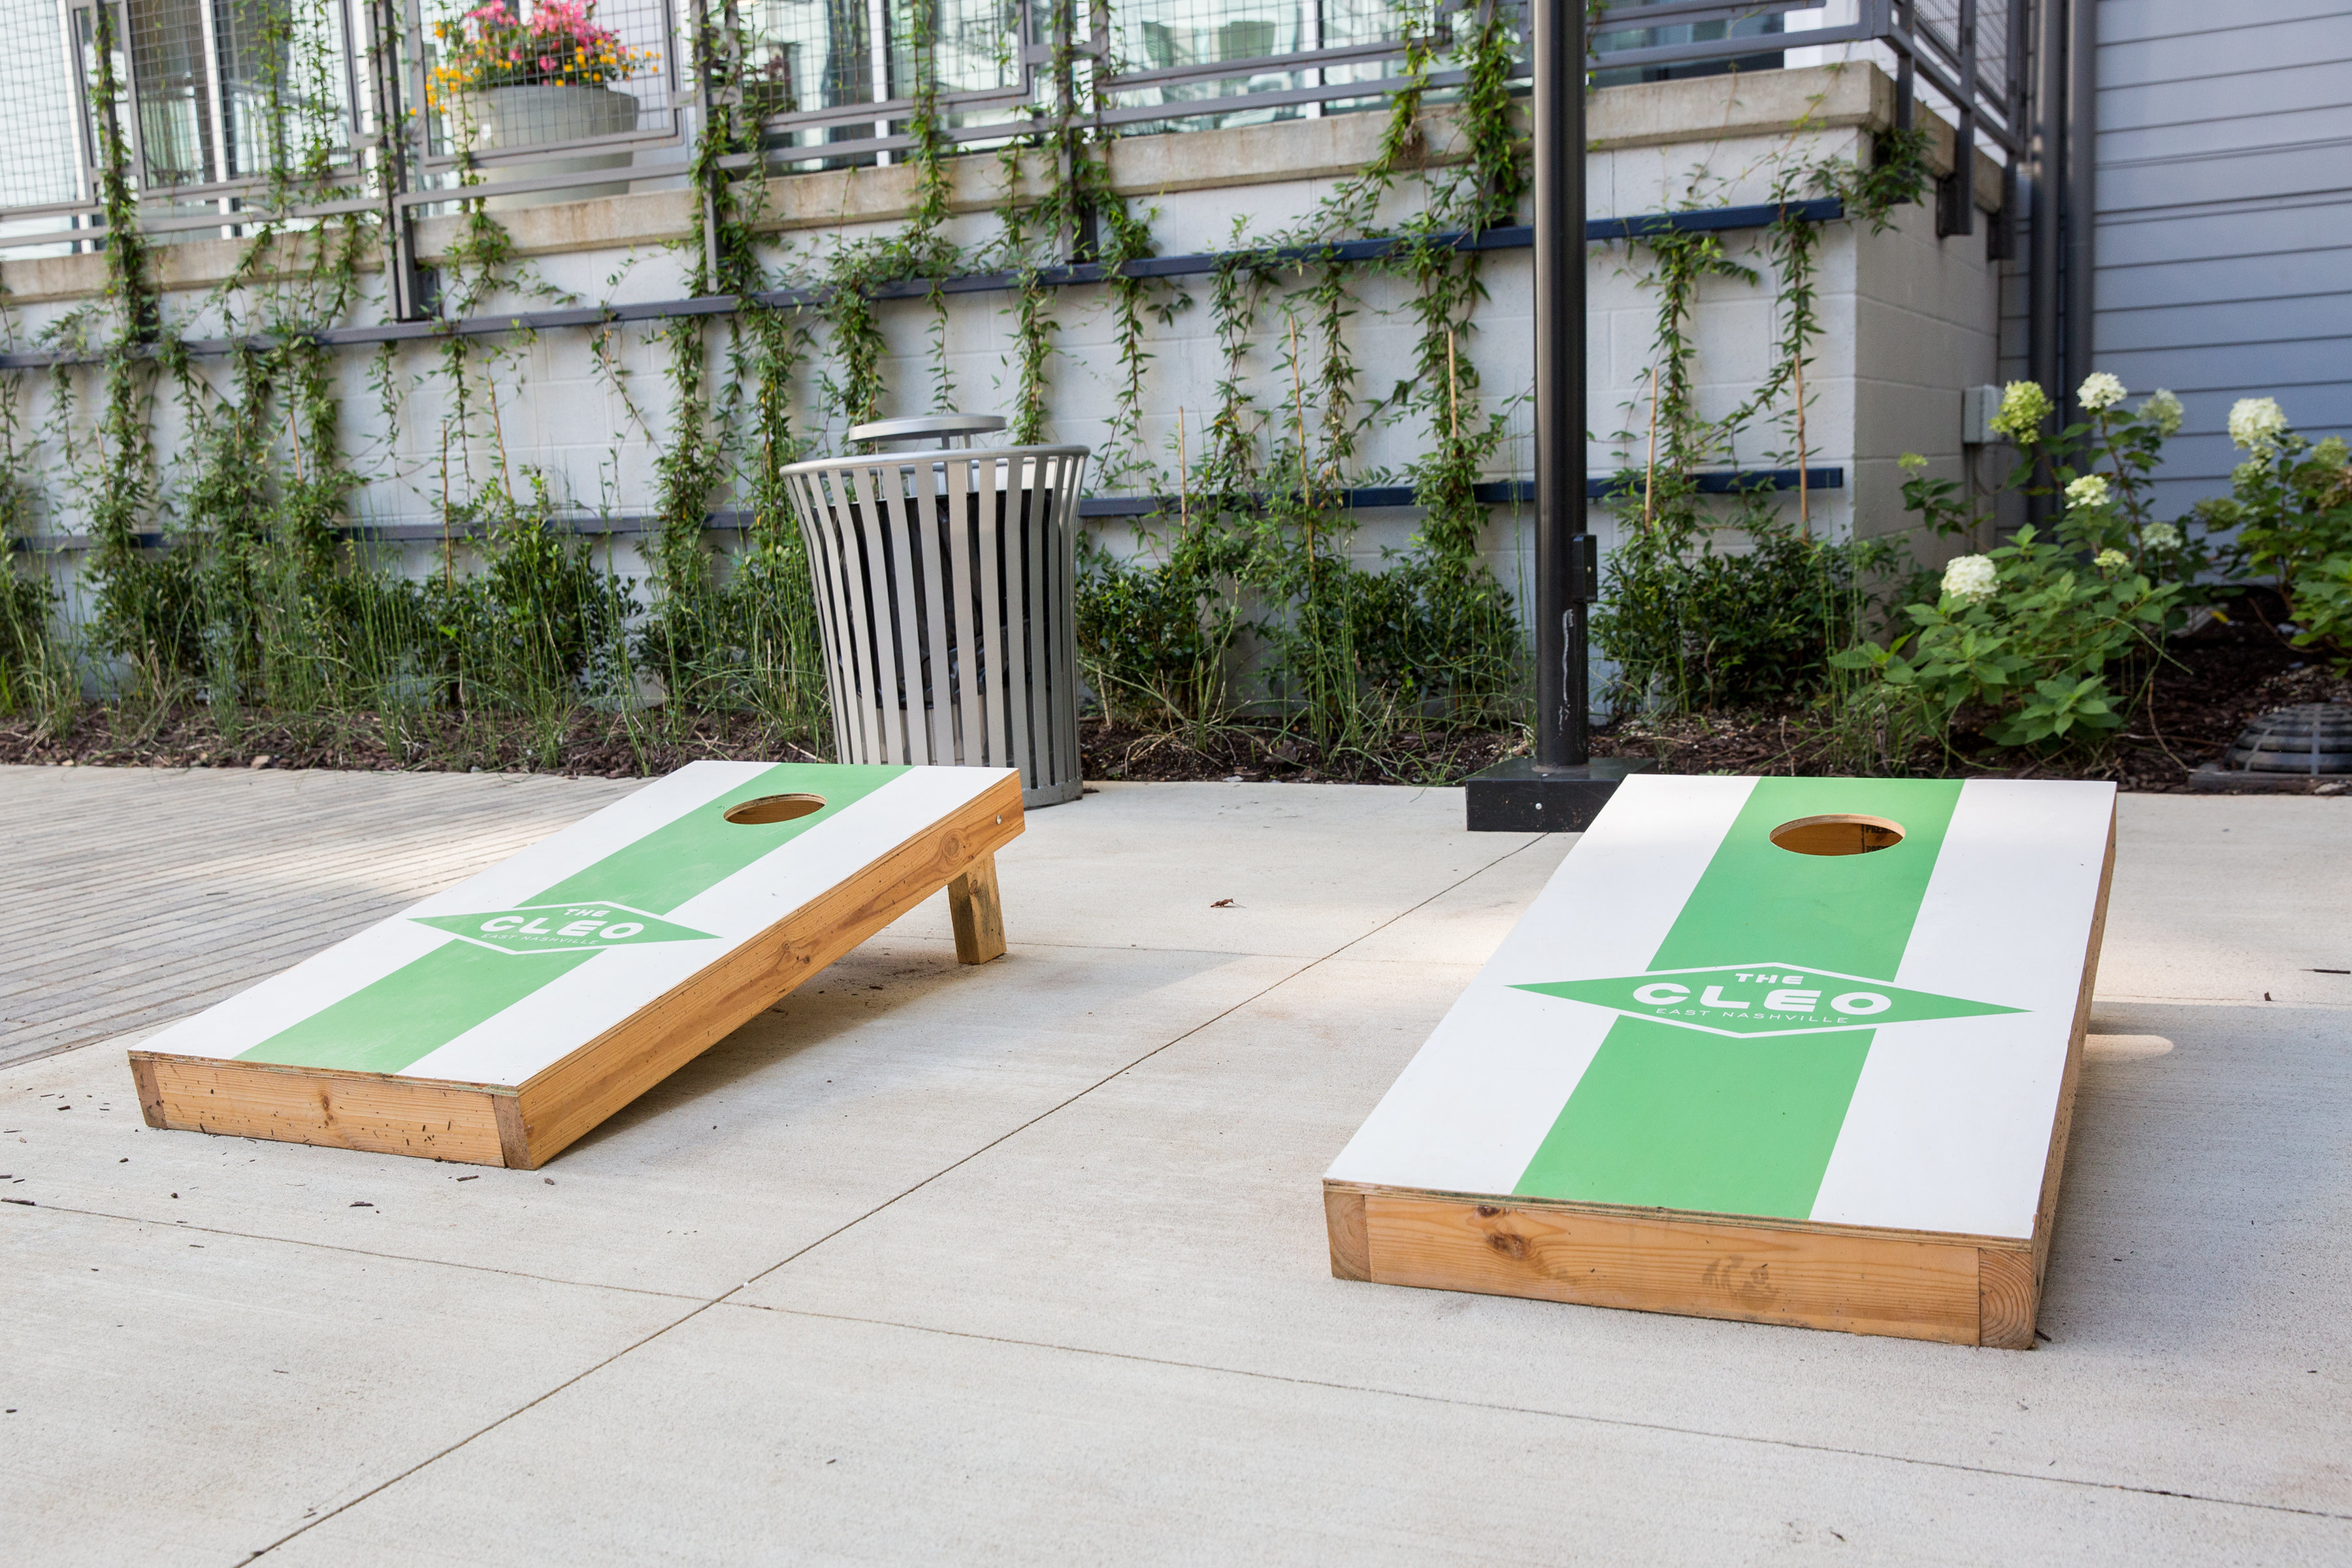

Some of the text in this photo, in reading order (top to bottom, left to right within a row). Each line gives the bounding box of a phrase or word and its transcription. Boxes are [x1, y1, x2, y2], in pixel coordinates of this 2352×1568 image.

[563, 909, 611, 917] THE
[480, 915, 644, 939] CLEO
[521, 936, 599, 945] NASHVILLE
[1735, 973, 1804, 985] THE
[1633, 983, 1892, 1015] CLEO
[1722, 1011, 1848, 1023] NASHVILLE
